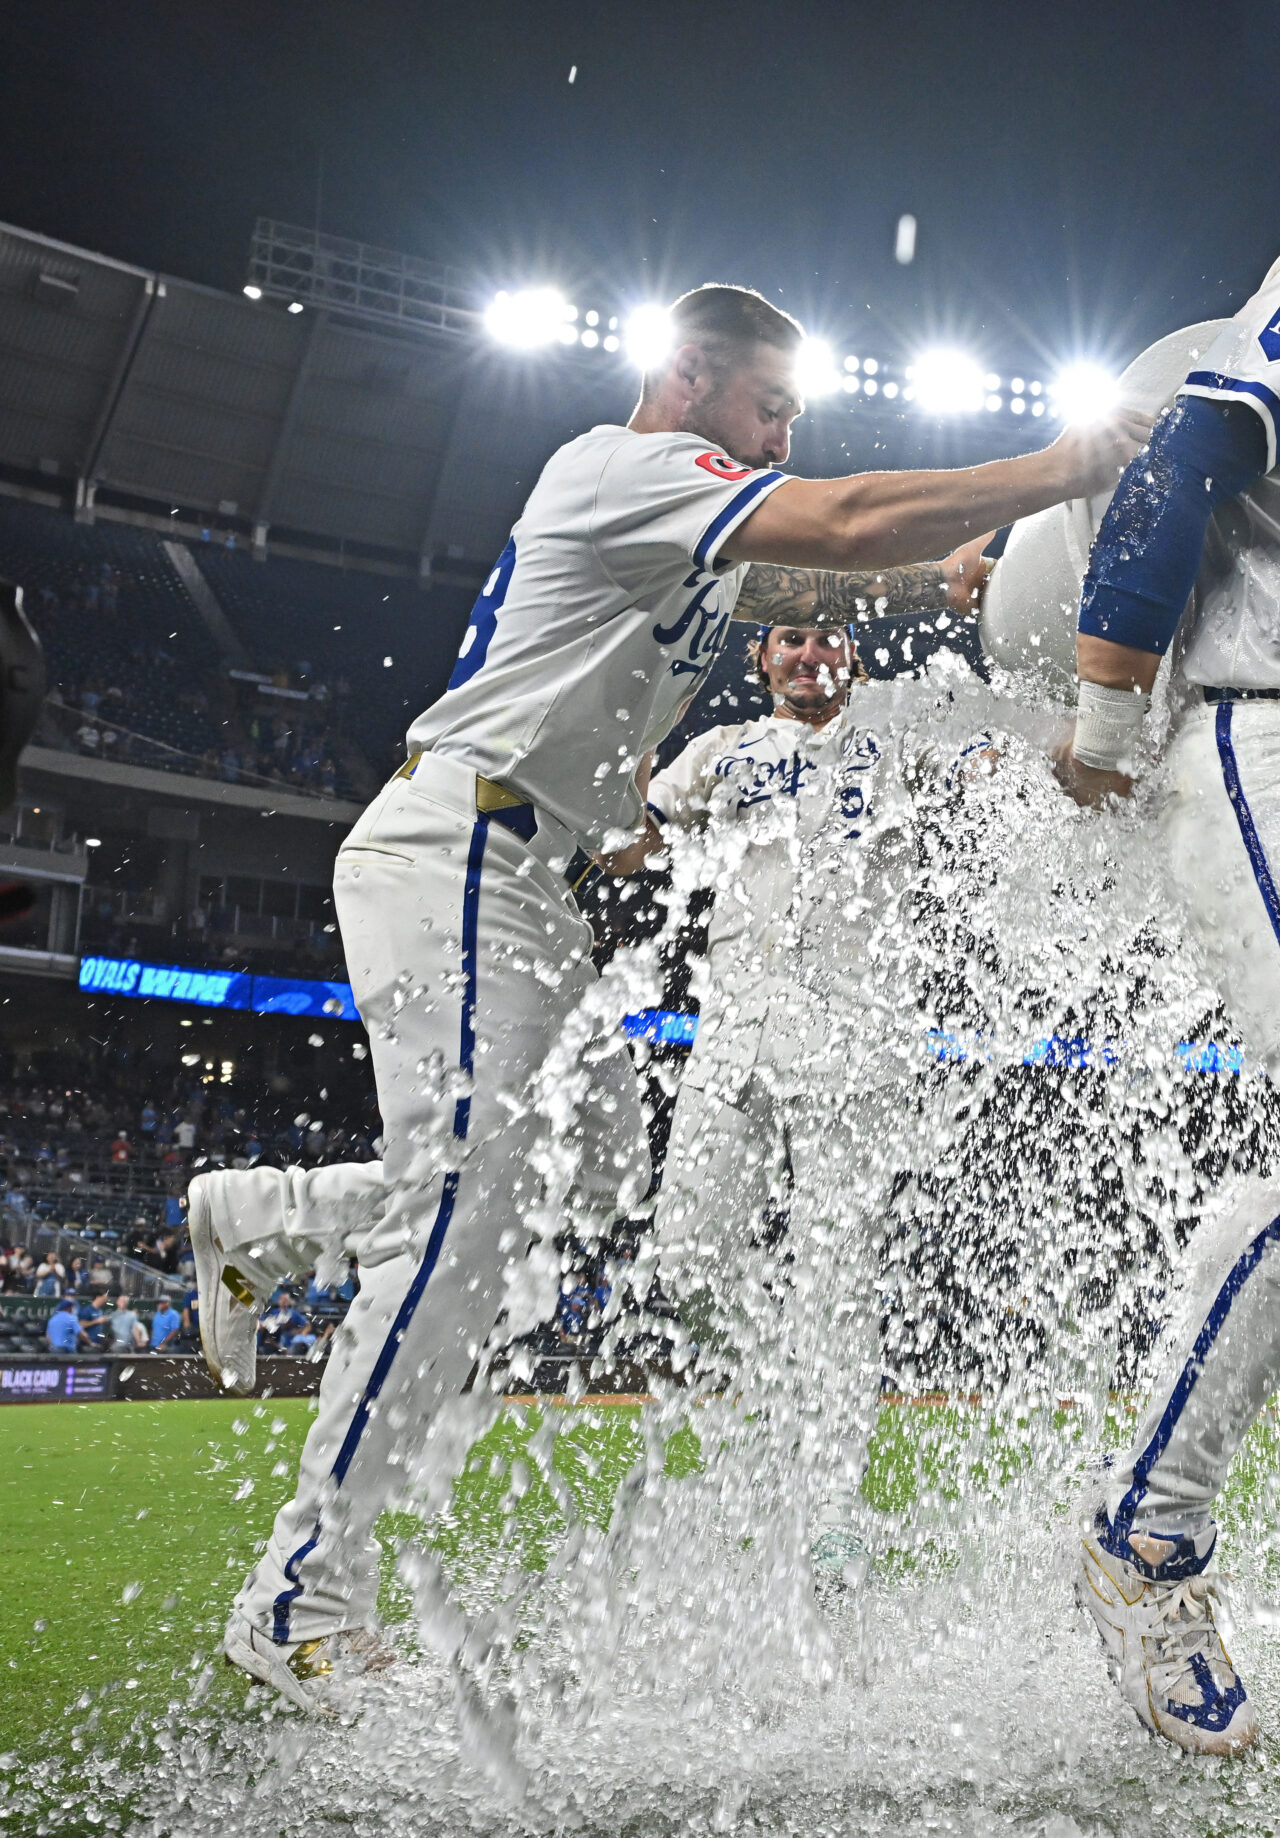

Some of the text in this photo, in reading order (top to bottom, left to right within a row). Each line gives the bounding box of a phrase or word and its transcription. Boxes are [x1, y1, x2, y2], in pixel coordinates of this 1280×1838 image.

[79, 957, 141, 991] OYALS
[2, 1369, 60, 1388] BLACK CARD
